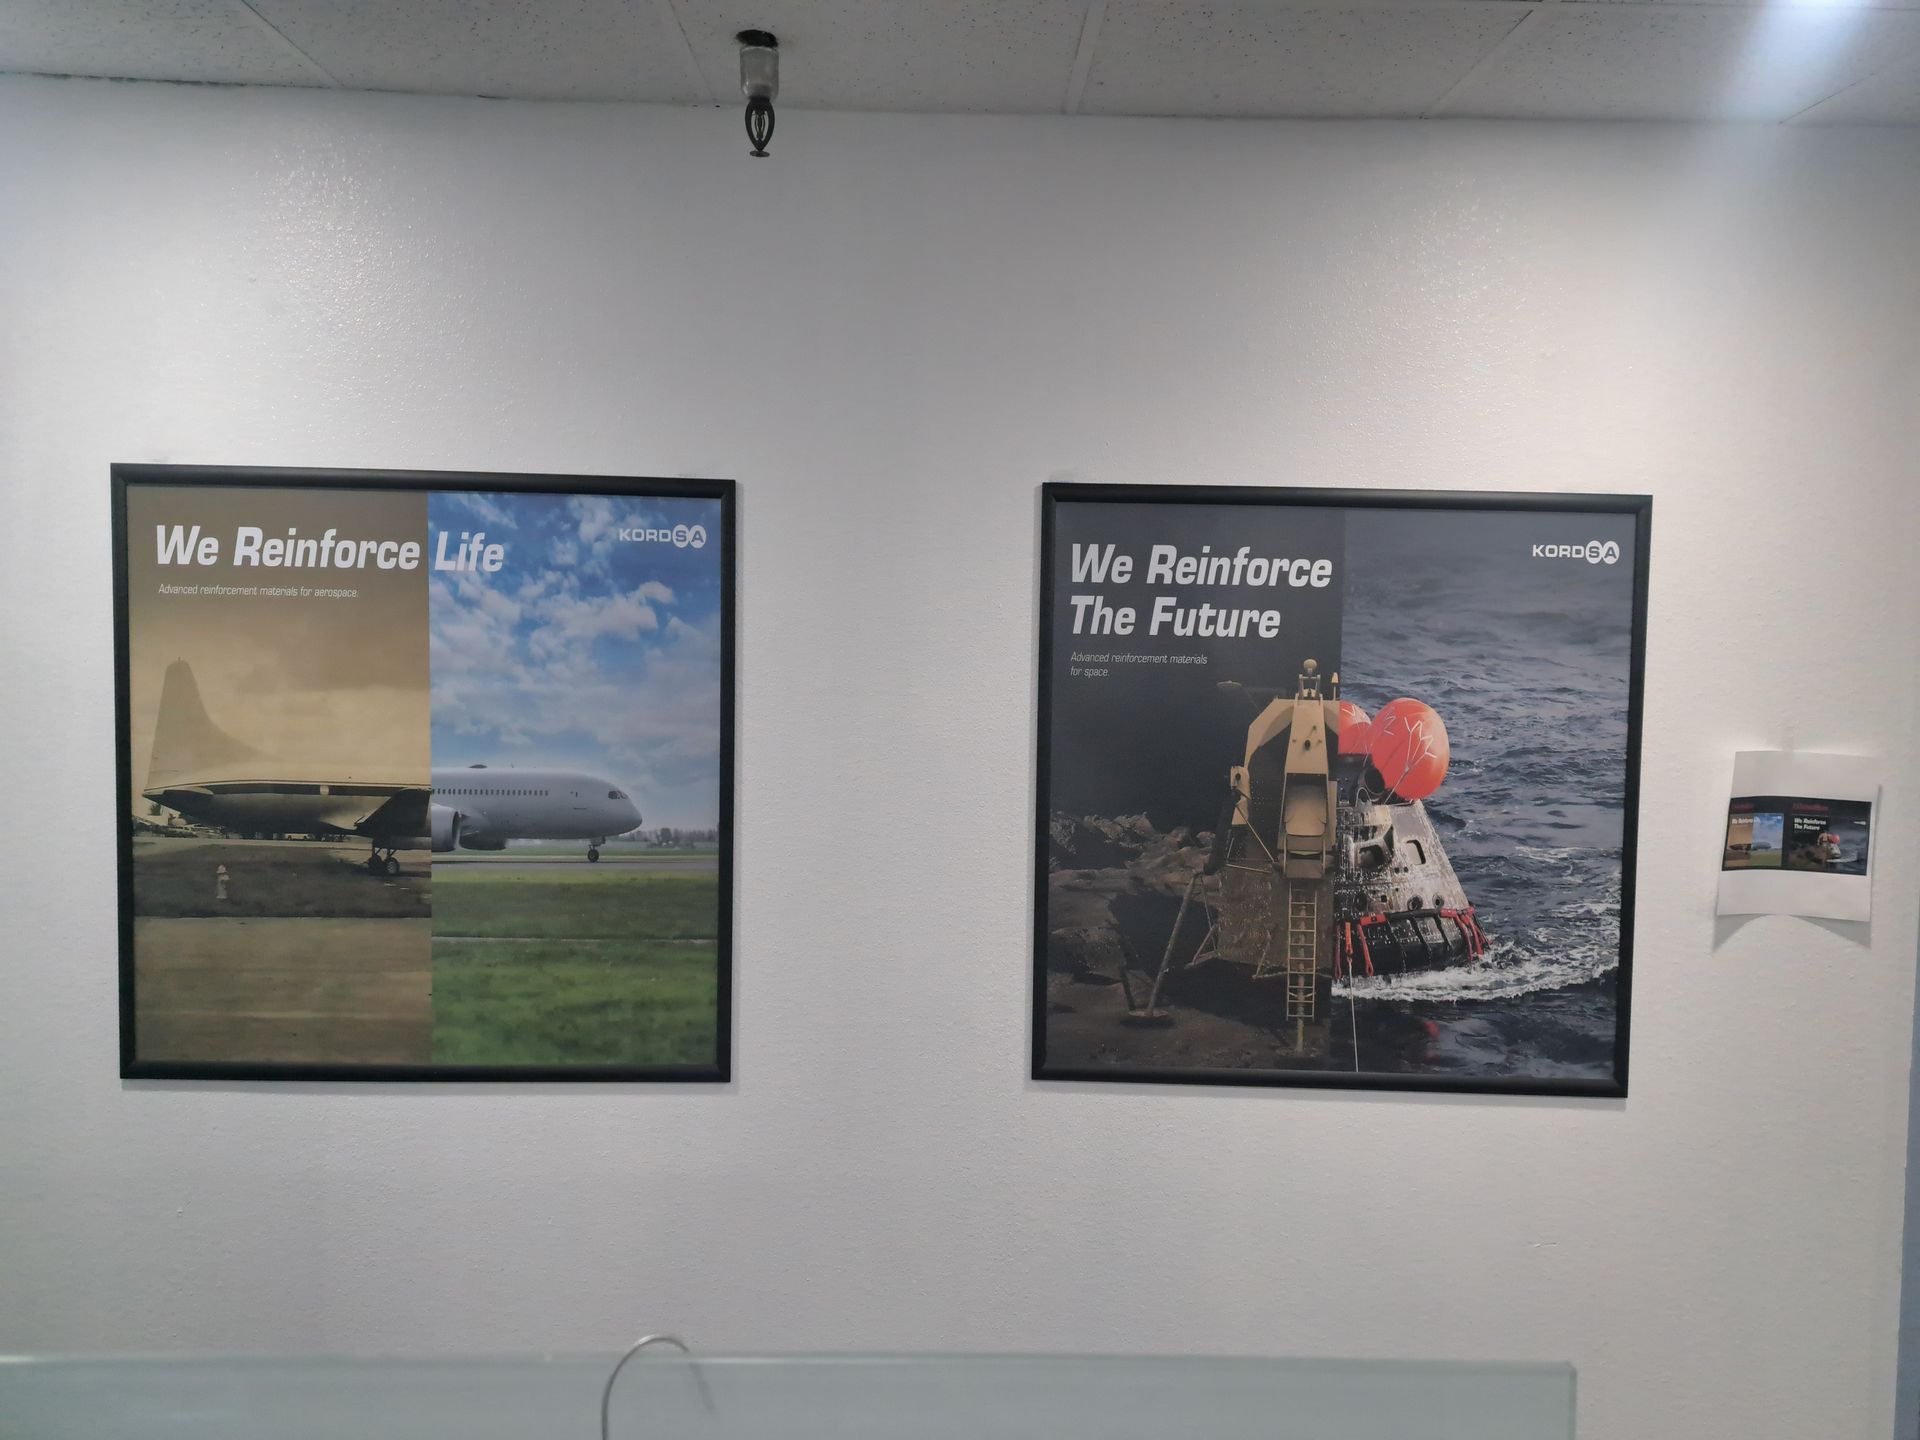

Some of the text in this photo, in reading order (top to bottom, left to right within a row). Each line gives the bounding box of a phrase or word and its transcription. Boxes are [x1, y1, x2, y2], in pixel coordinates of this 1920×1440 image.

[157, 525, 505, 572] We Reinforce Life
[619, 524, 707, 549] KORDSA
[1532, 540, 1620, 565] KORDSA
[1071, 543, 1333, 588] We Reinforce
[158, 584, 198, 595] Advanced
[200, 585, 257, 596] reinforcement
[259, 586, 298, 597] materials
[300, 586, 312, 597] for
[1070, 595, 1281, 638] The Future
[1070, 651, 1208, 665] Advanced reinforcement materials
[1070, 666, 1082, 677] for
